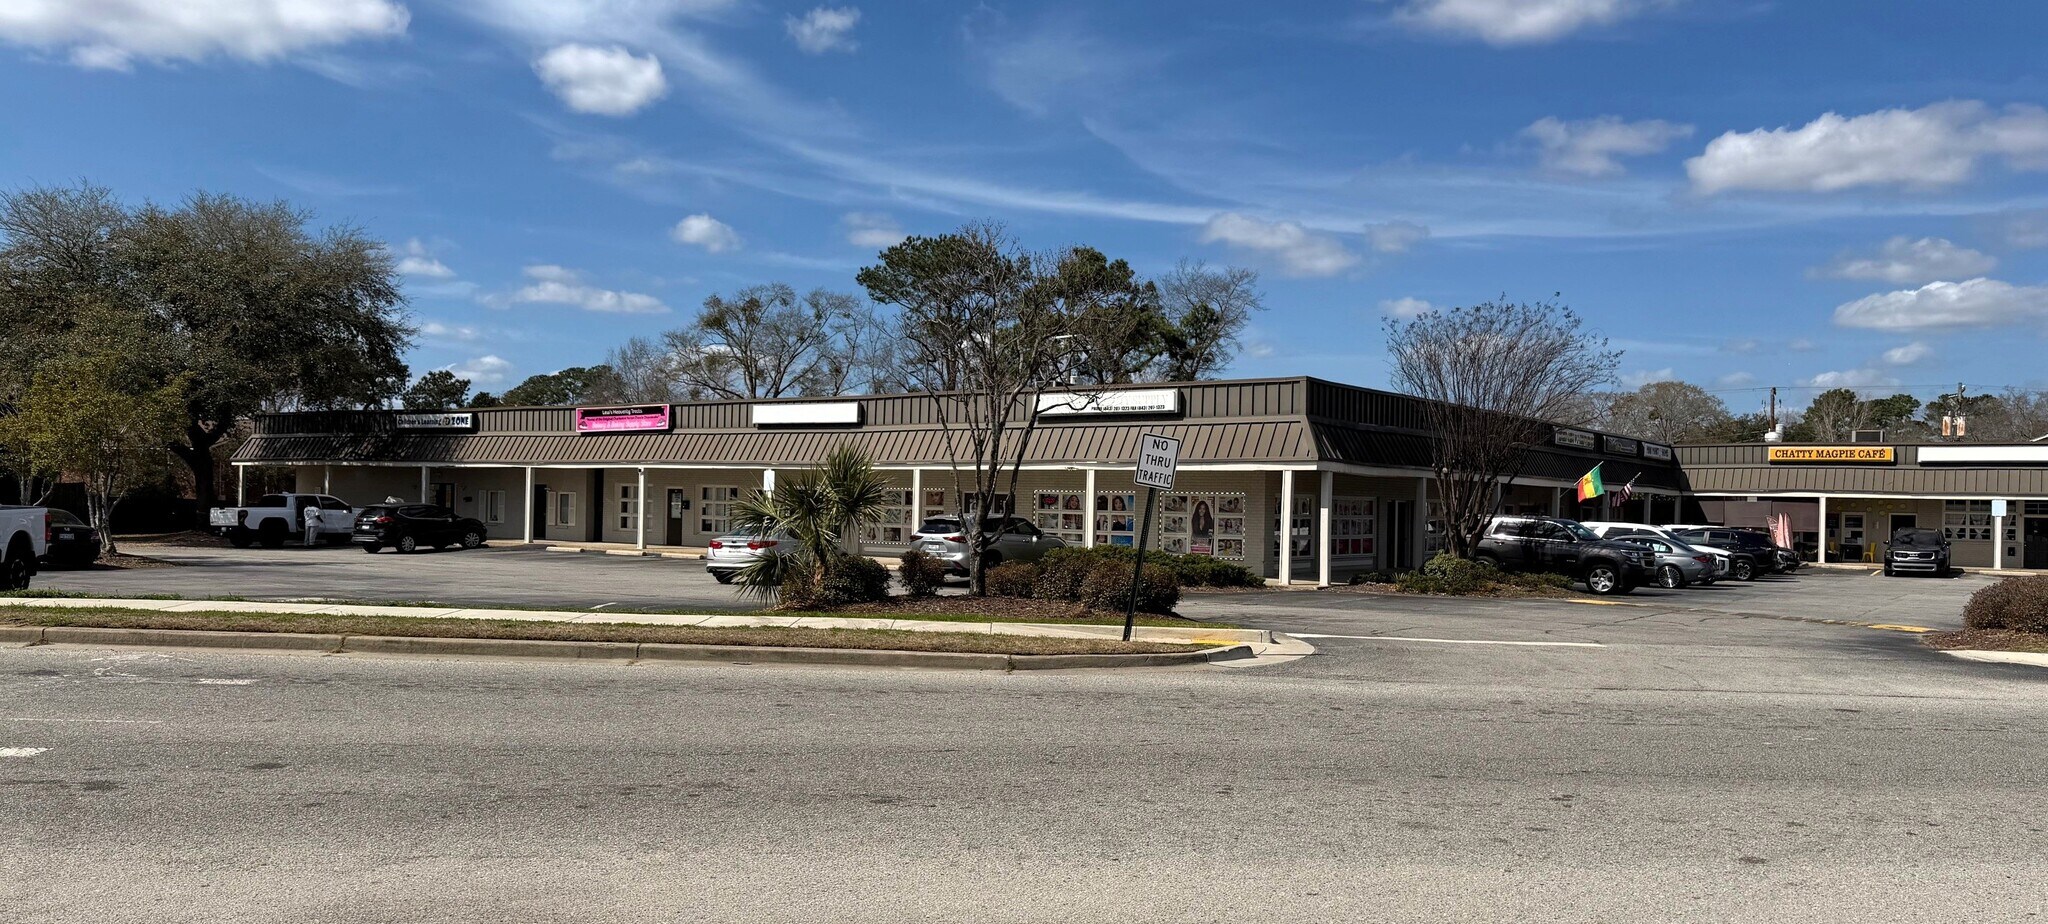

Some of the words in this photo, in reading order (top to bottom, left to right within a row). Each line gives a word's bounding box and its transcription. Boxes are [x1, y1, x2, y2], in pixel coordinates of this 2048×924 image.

[451, 416, 469, 425] ZONE
[1152, 439, 1169, 451] NO
[1775, 449, 1813, 458] CHATTY
[1816, 449, 1855, 458] MAGPIE
[1858, 448, 1885, 458] CAFÉ
[1146, 454, 1171, 468] THRU
[1139, 469, 1172, 485] TRAFFIC
